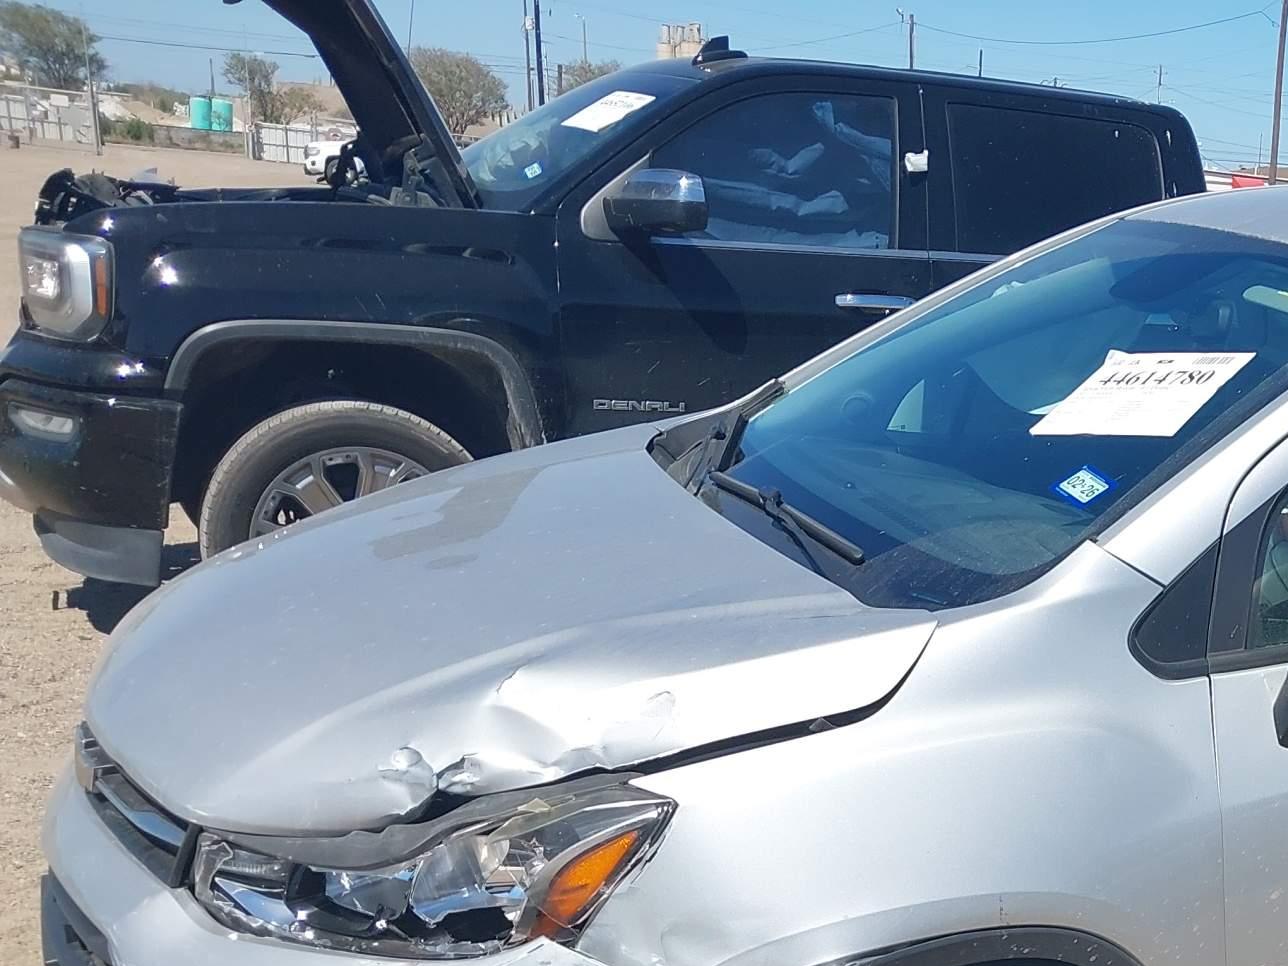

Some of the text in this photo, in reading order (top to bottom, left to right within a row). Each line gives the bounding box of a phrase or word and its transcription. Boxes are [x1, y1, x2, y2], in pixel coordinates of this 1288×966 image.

[1099, 369, 1216, 386] 44614780
[593, 399, 685, 412] DENALI
[1066, 475, 1085, 489] 02
[1080, 484, 1100, 498] 26
